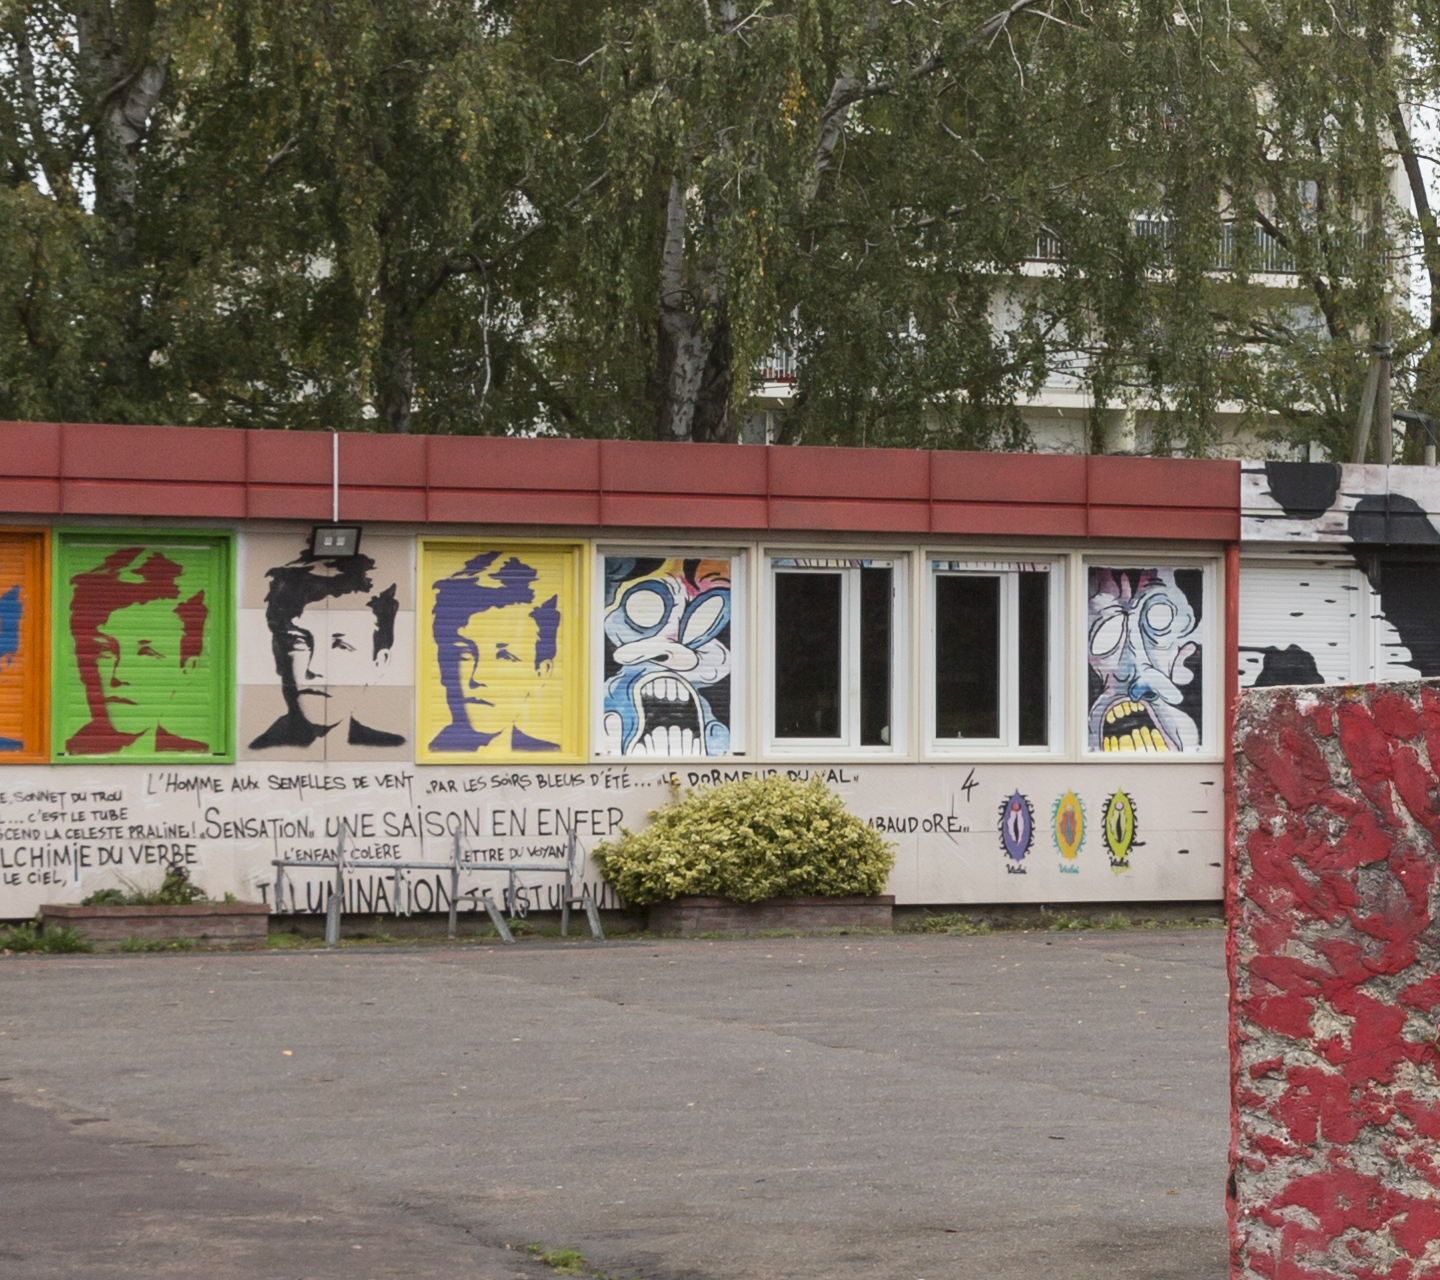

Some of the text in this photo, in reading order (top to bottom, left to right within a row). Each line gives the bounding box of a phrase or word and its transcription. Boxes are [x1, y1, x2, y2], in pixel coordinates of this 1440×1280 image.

[267, 773, 346, 801] SEMELLES
[352, 774, 370, 789] DE
[463, 776, 487, 792] LES
[71, 793, 87, 803] DU
[91, 791, 122, 803] TROU
[71, 811, 87, 822] LE
[91, 808, 128, 821] TUBE
[325, 813, 376, 838] UNE
[492, 808, 526, 837] EN
[538, 807, 624, 836] ENFER
[45, 828, 62, 840] LA
[66, 826, 124, 840] CELESTE
[98, 845, 123, 866] DU
[129, 844, 197, 866] VERBE
[510, 847, 524, 860] DU
[3, 872, 21, 886] LE
